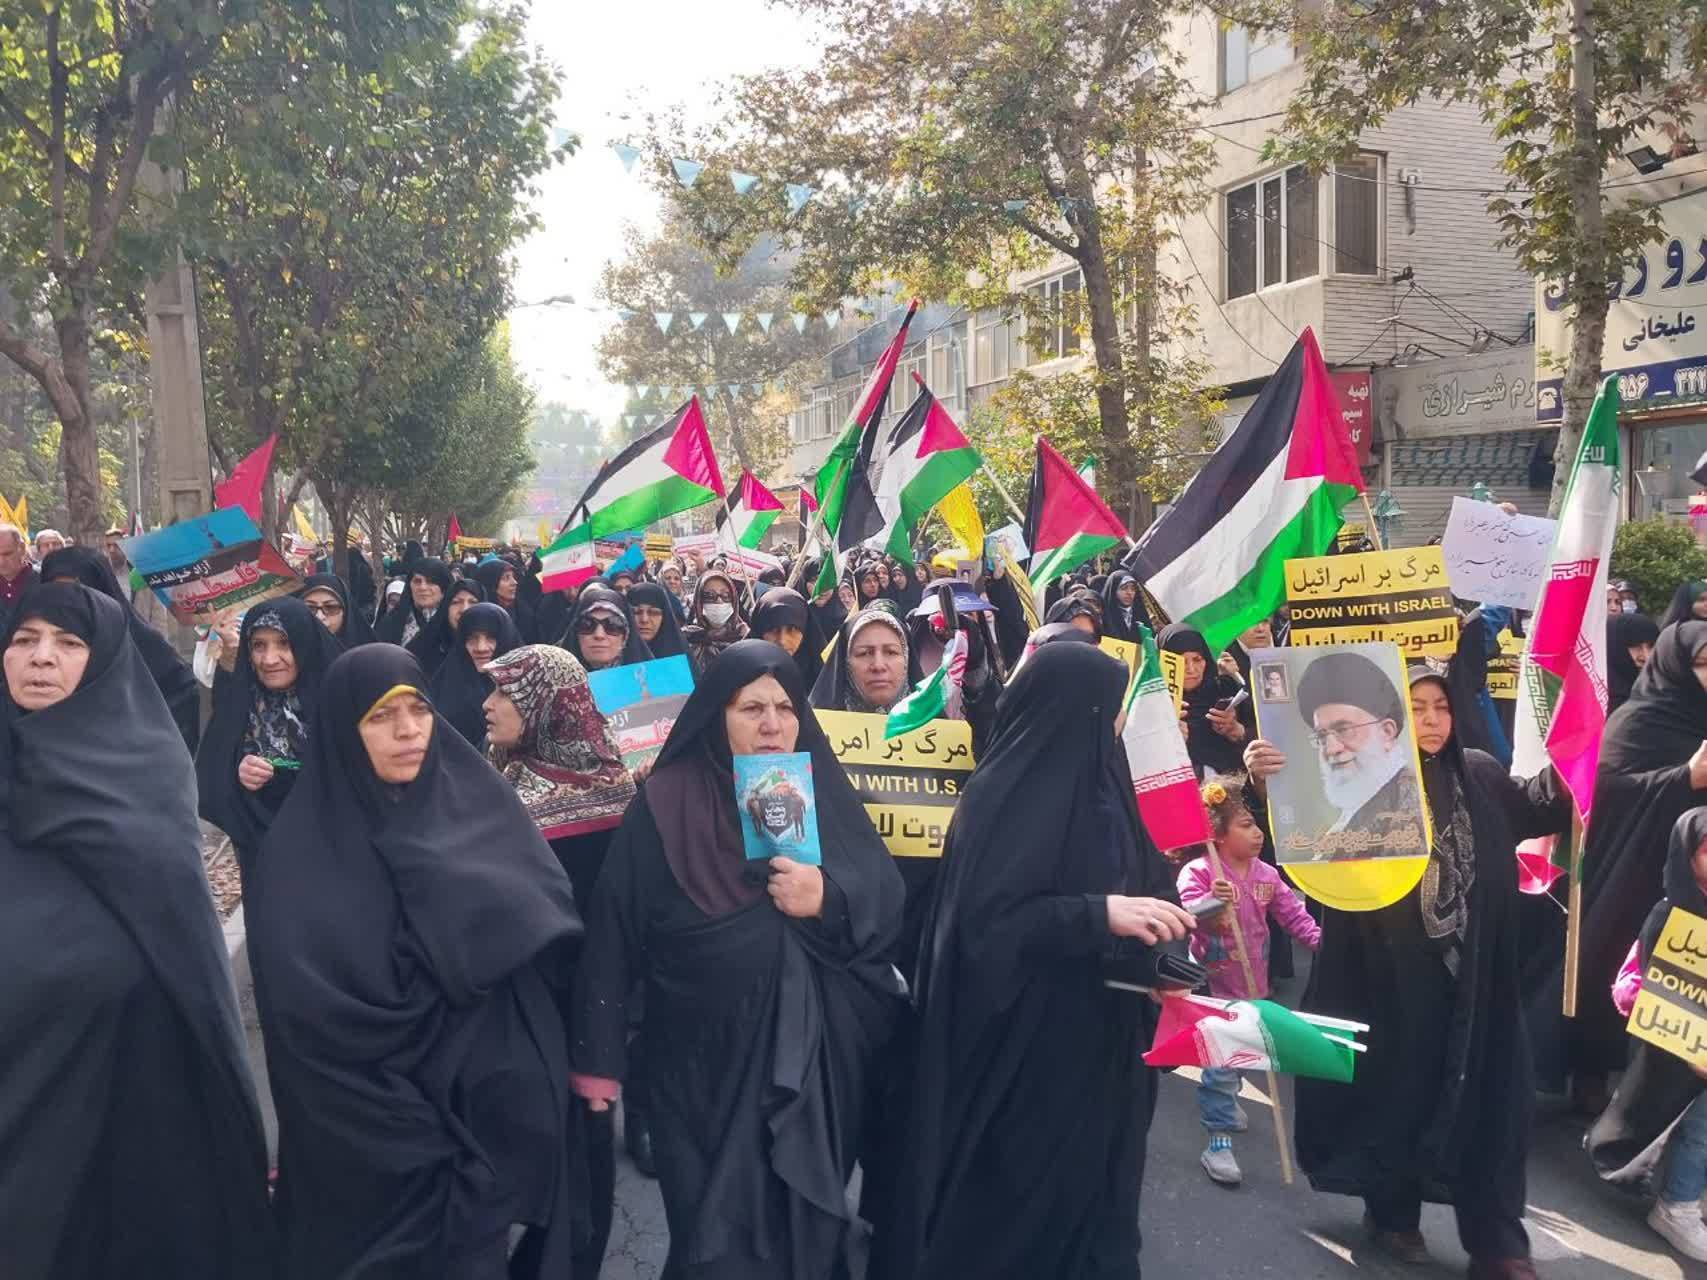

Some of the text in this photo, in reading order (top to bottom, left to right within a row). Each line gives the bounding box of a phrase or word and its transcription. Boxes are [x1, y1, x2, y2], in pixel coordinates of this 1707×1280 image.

[1292, 564, 1365, 594] اسرائیل
[1373, 569, 1392, 588] بر
[1400, 555, 1440, 583] مرگ
[1291, 595, 1451, 621] DOWN WITH ISRAEL
[881, 738, 903, 761] بر
[914, 729, 968, 763] مرگ
[865, 775, 919, 793] WITH
